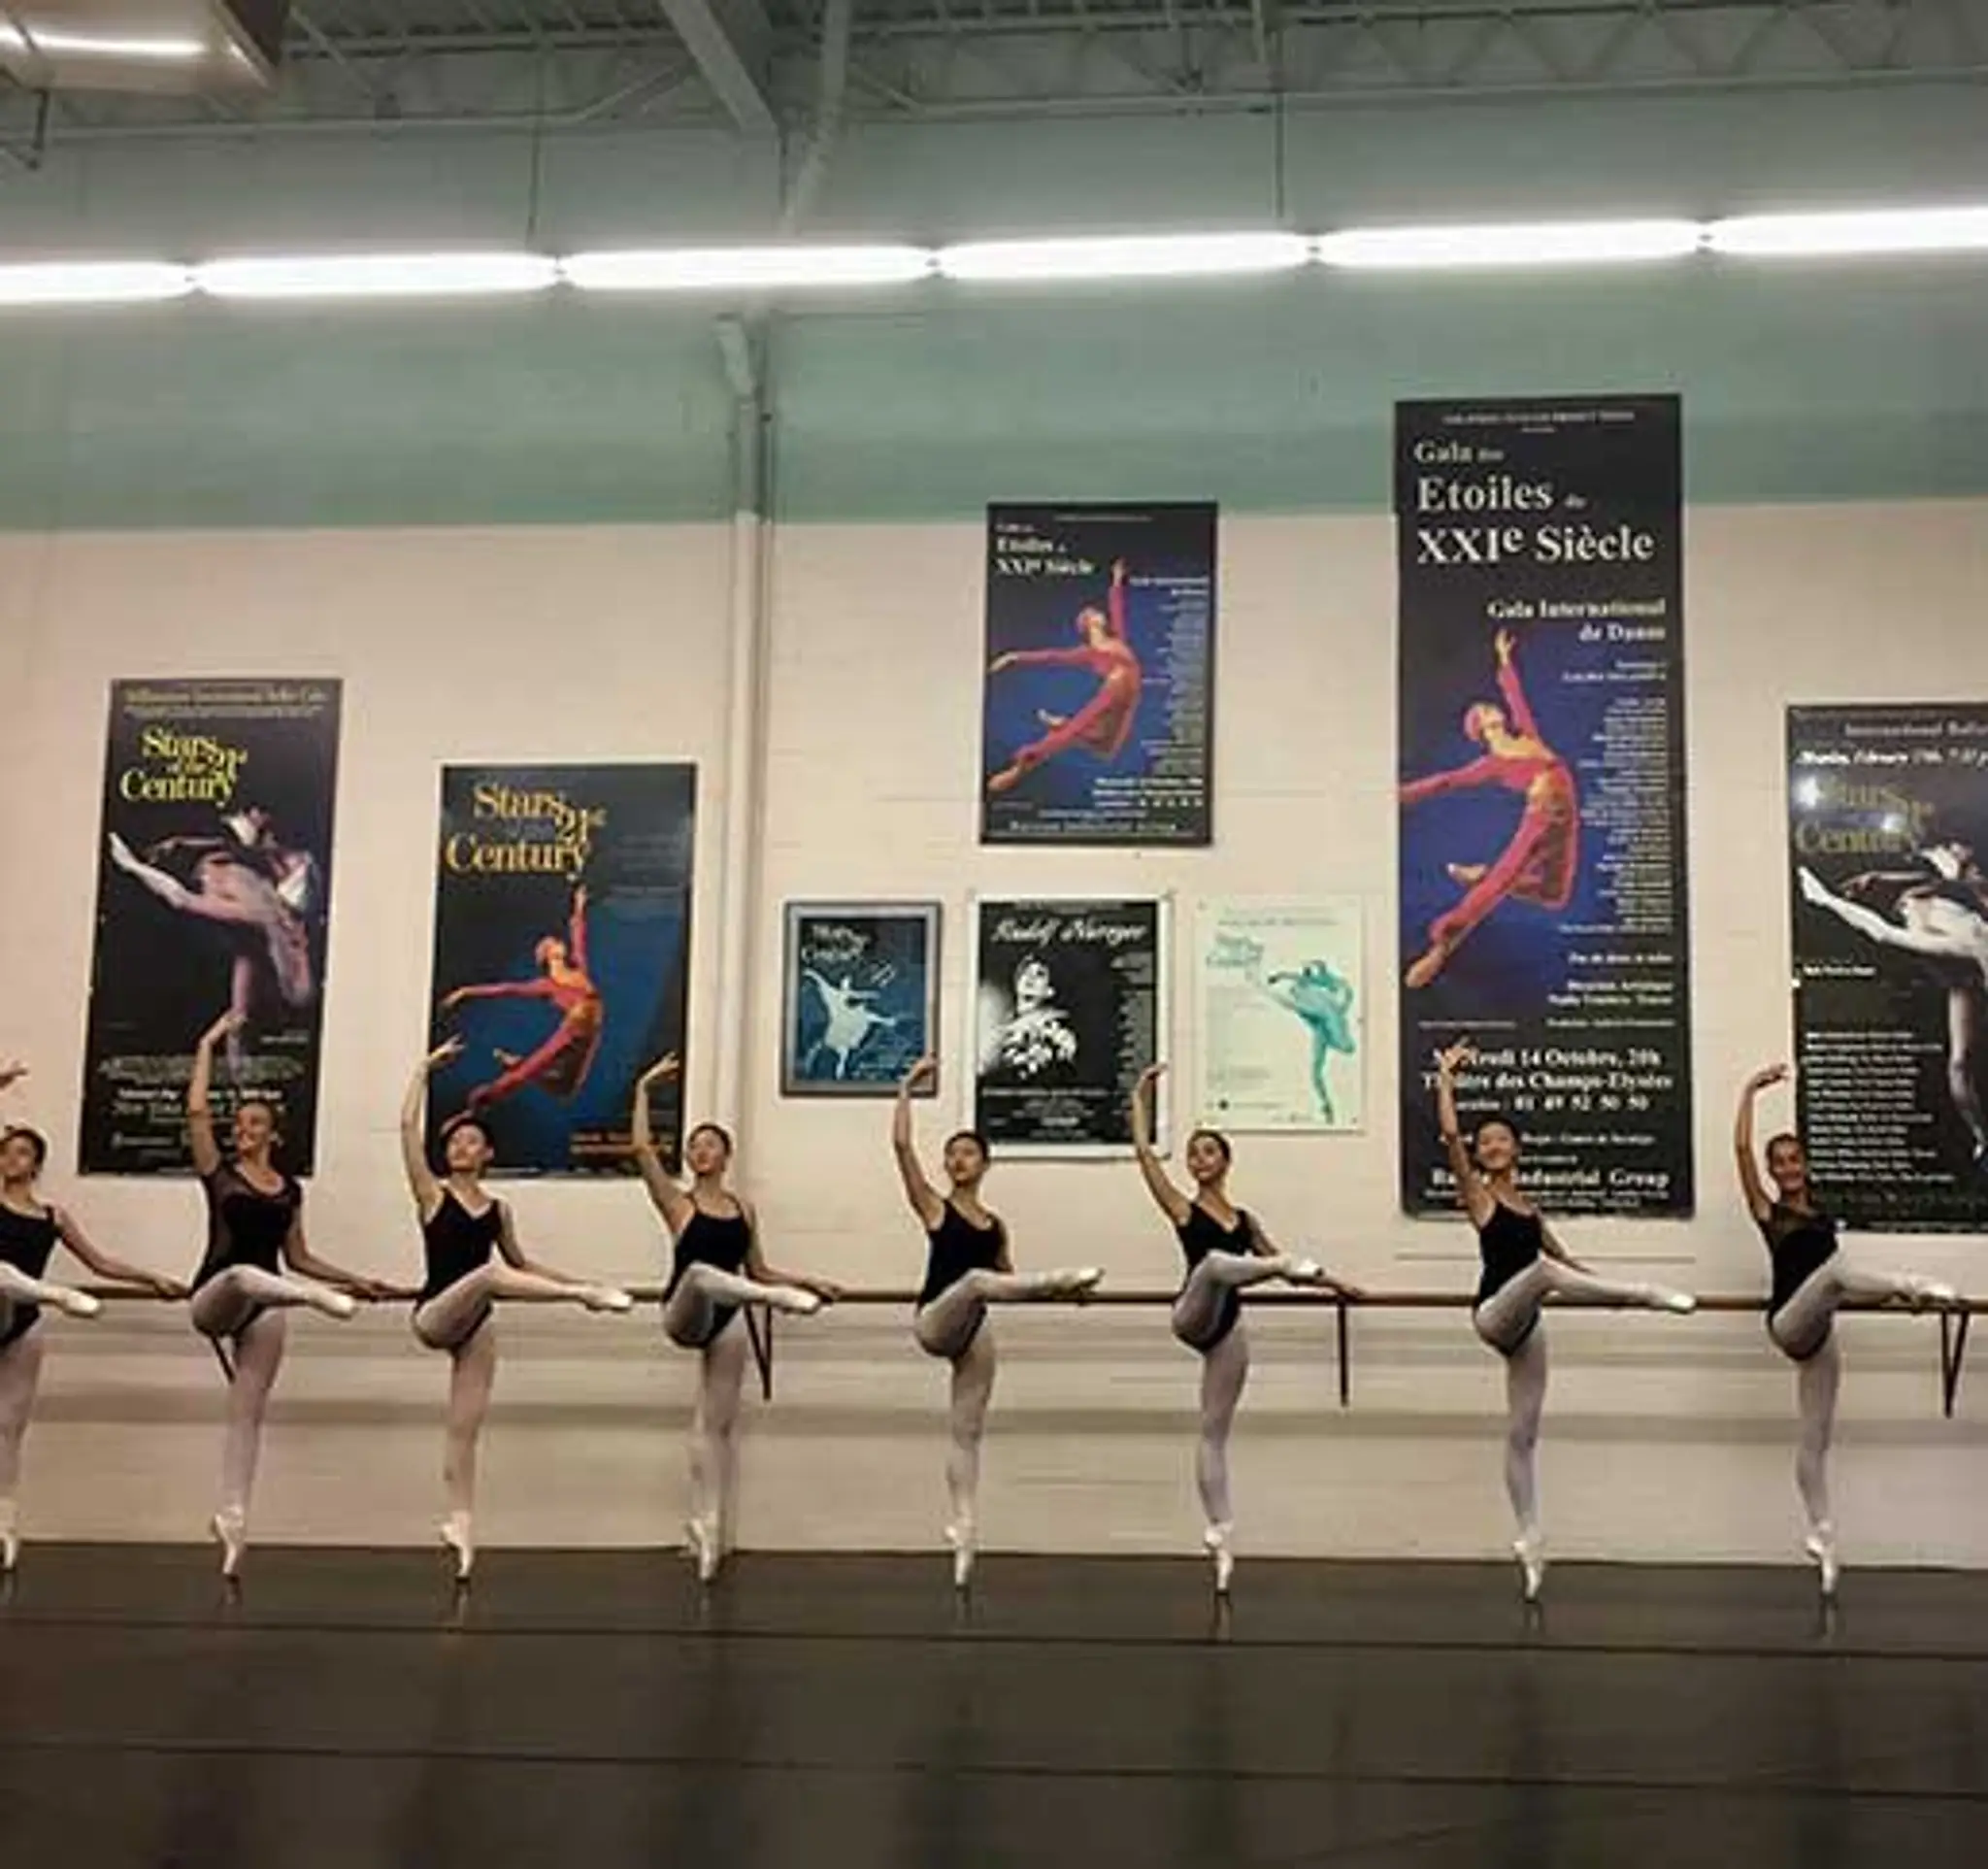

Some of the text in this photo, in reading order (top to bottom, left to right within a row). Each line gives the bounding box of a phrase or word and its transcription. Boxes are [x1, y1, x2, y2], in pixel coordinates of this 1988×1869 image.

[1414, 440, 1473, 463] Gala
[1416, 475, 1554, 512] Etoiles
[1416, 524, 1655, 564] XXIe Siècle
[1486, 598, 1667, 619] Gala International
[142, 727, 219, 757] Stars
[119, 768, 236, 809] Century
[474, 782, 568, 819] Stars
[445, 832, 591, 882] Century
[1609, 1167, 1671, 1188] Group
